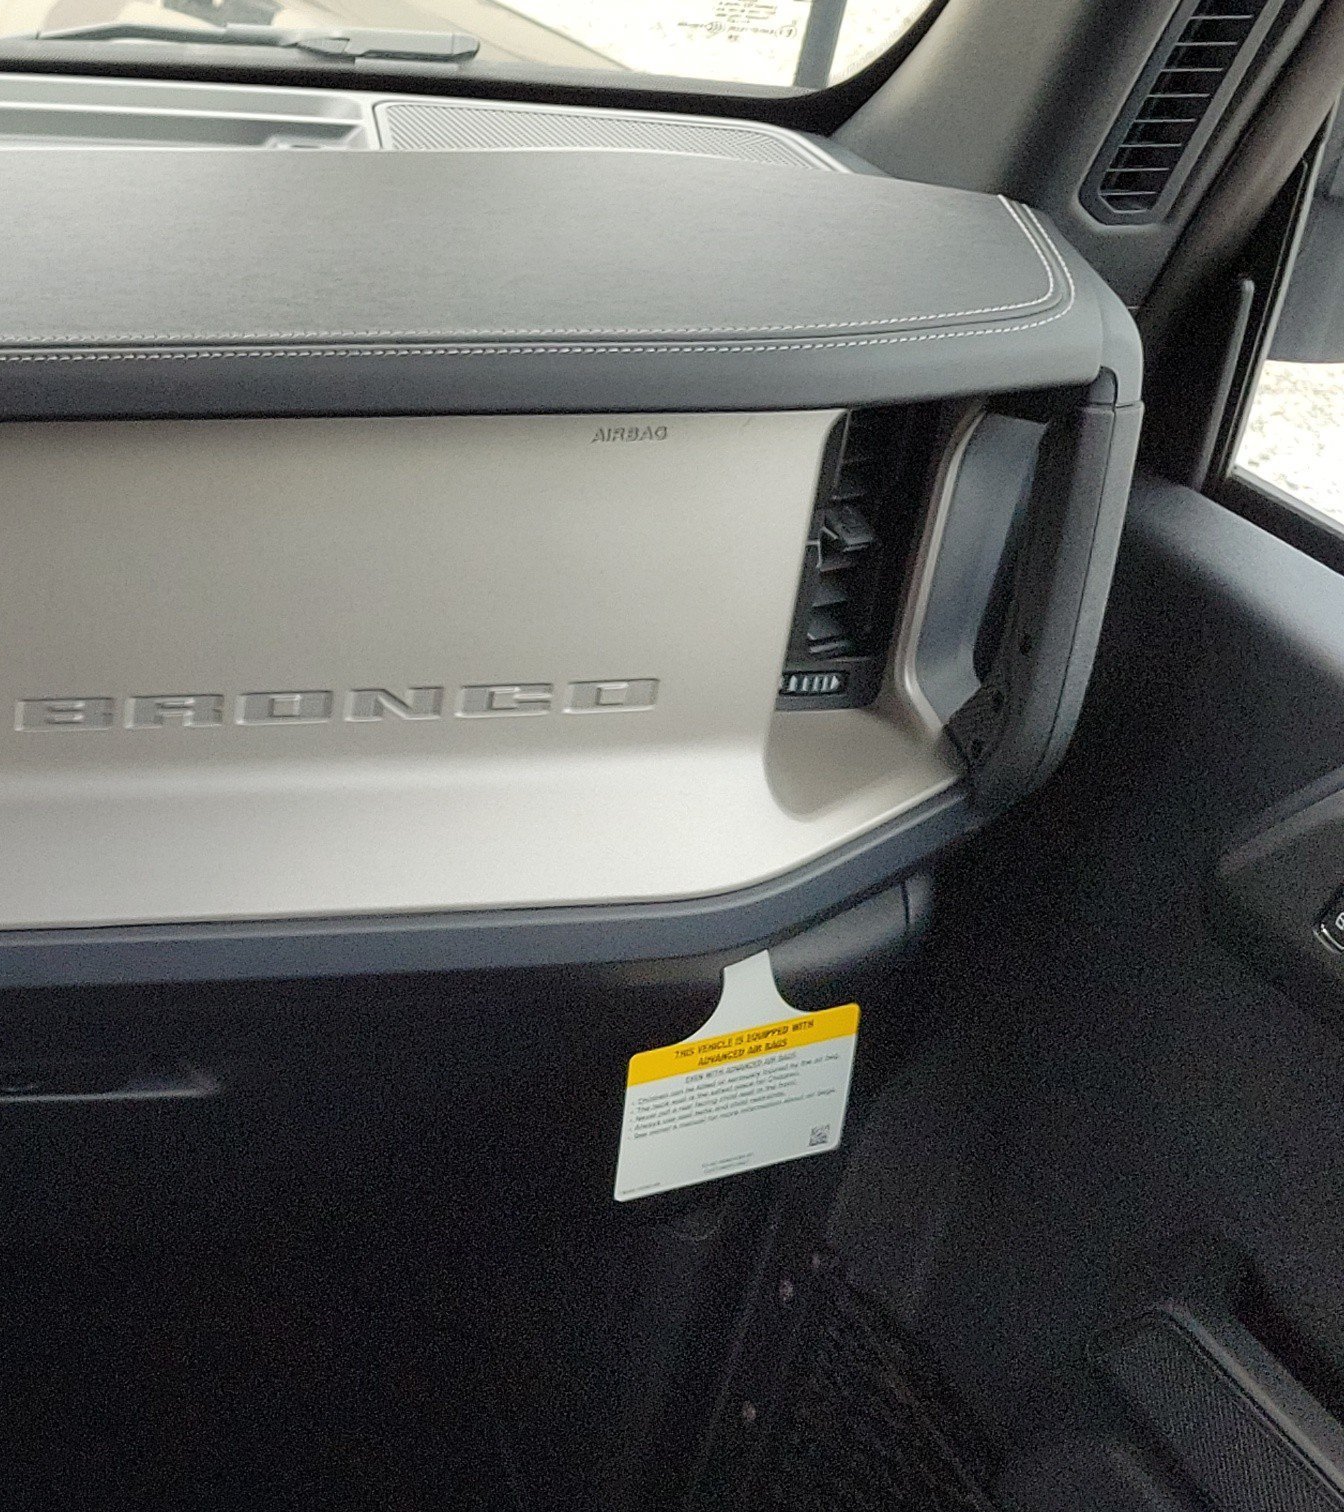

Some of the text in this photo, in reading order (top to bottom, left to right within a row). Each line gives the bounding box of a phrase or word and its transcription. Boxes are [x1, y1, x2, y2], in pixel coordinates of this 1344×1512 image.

[591, 426, 667, 443] AIRBAG
[13, 677, 661, 732] BRONCO
[673, 1047, 695, 1059] THIS
[697, 1038, 733, 1053] VEHICLE
[791, 1019, 814, 1032] WITH
[697, 1037, 788, 1066] ADVANCED AIR BAGS
